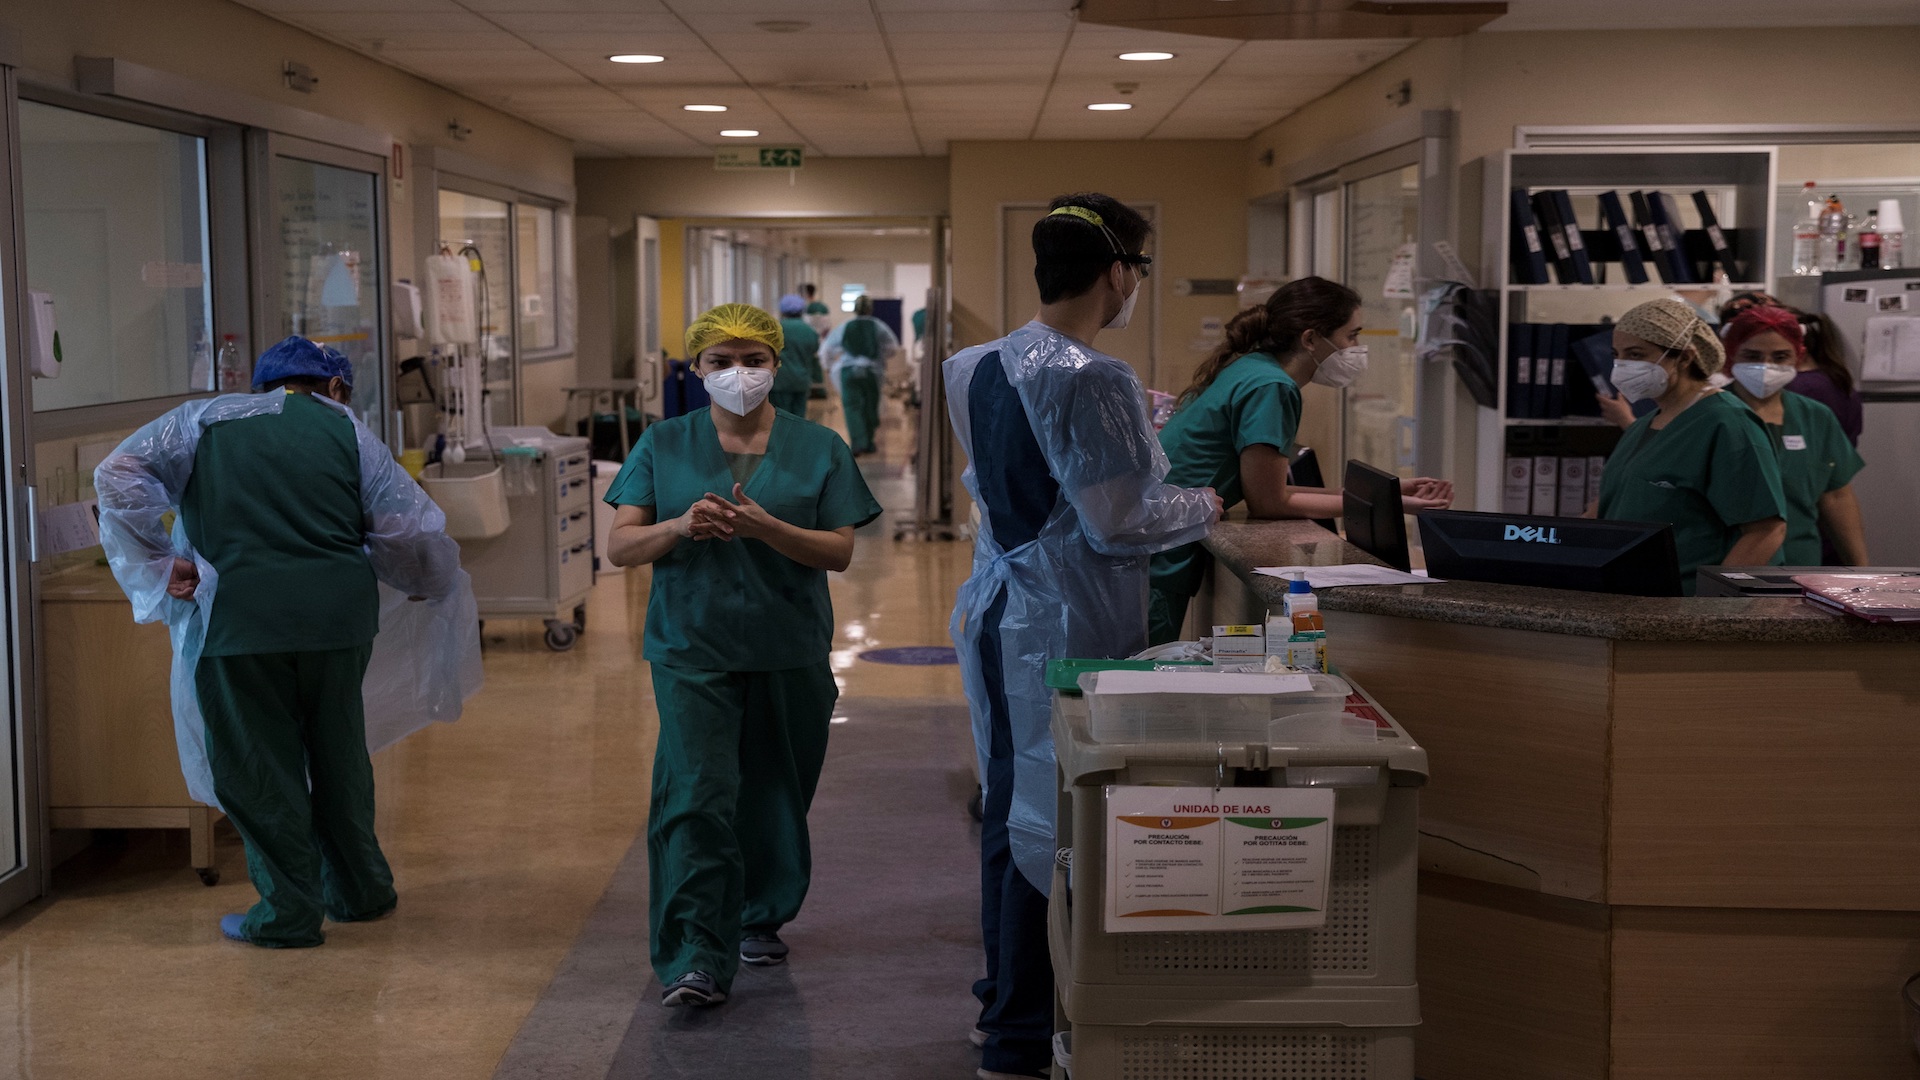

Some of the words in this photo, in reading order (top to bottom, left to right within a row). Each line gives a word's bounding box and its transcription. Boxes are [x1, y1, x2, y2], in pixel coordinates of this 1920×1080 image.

[1503, 524, 1561, 544] DELL
[1173, 805, 1220, 813] UNIDAD
[1223, 805, 1239, 814] DE
[1243, 805, 1271, 814] IAAS
